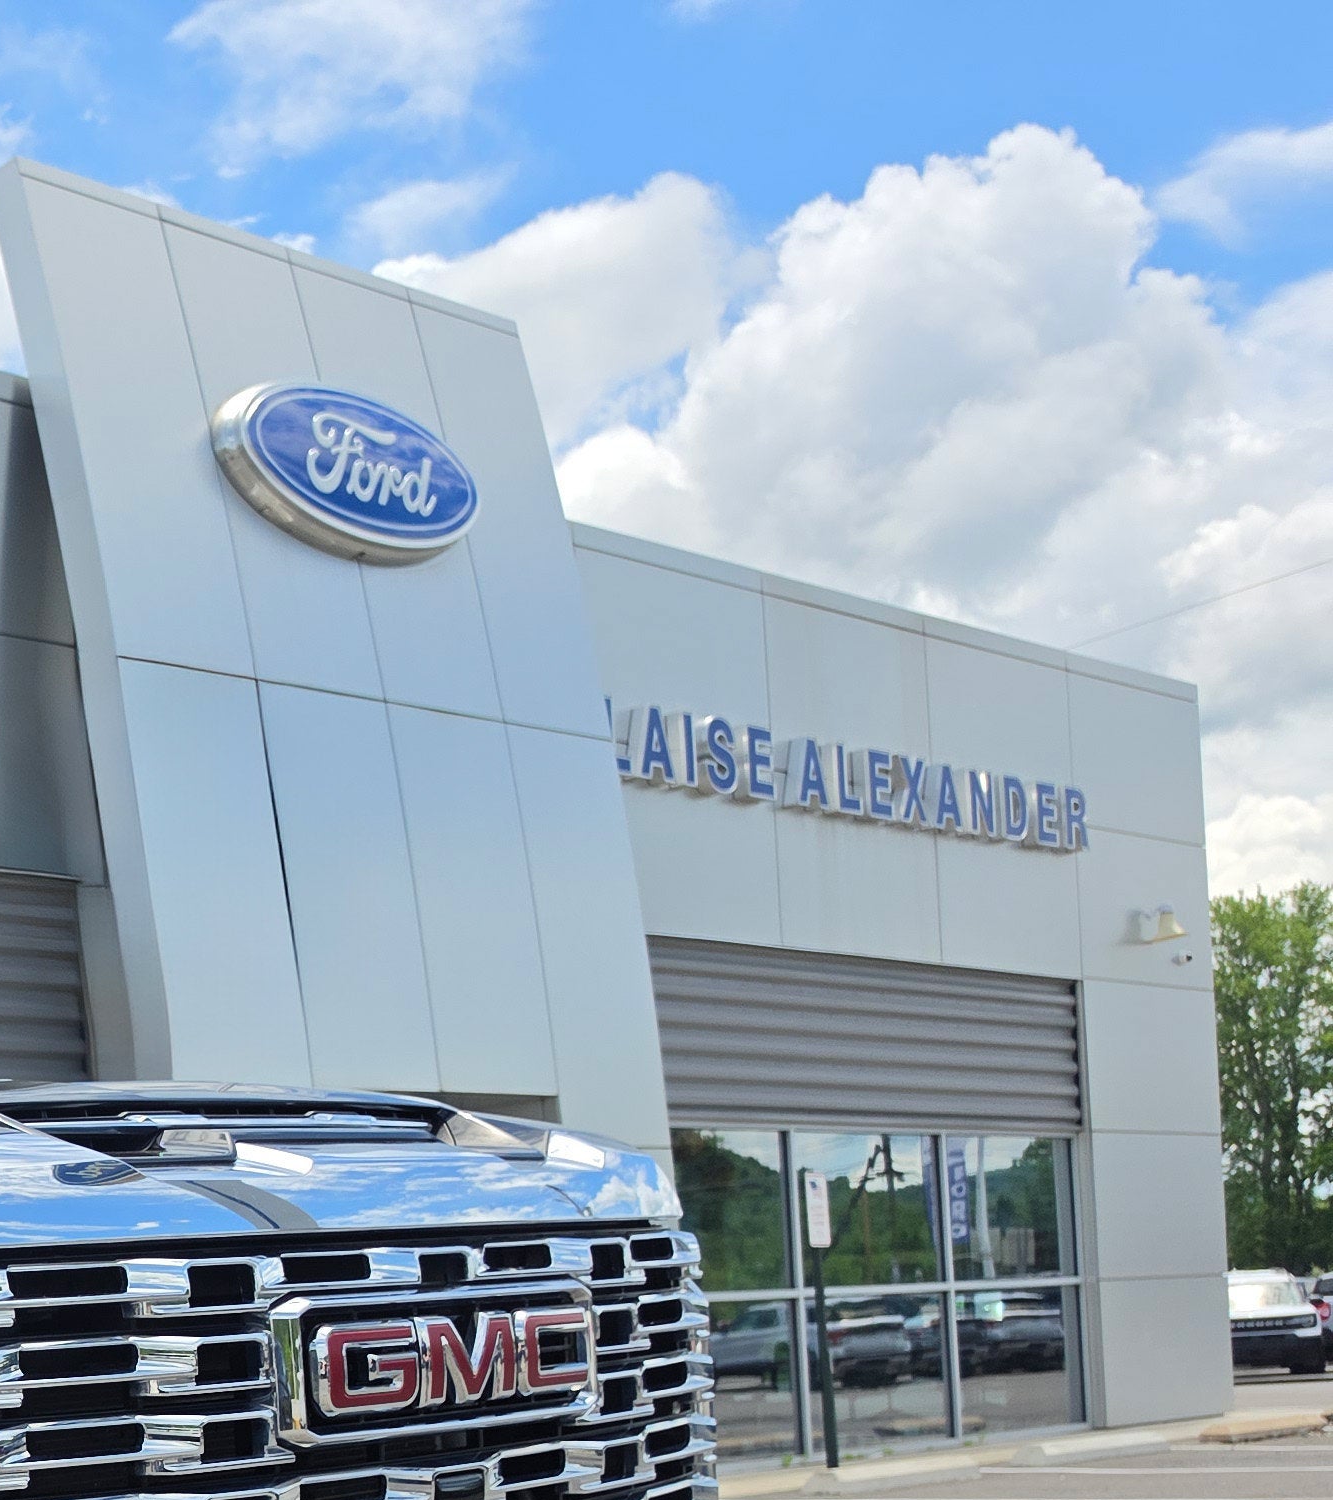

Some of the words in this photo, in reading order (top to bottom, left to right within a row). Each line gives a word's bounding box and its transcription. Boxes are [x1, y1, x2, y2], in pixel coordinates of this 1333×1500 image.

[306, 411, 437, 517] Ford
[799, 735, 1090, 850] ALEXANDER
[313, 1307, 590, 1415] GMC
